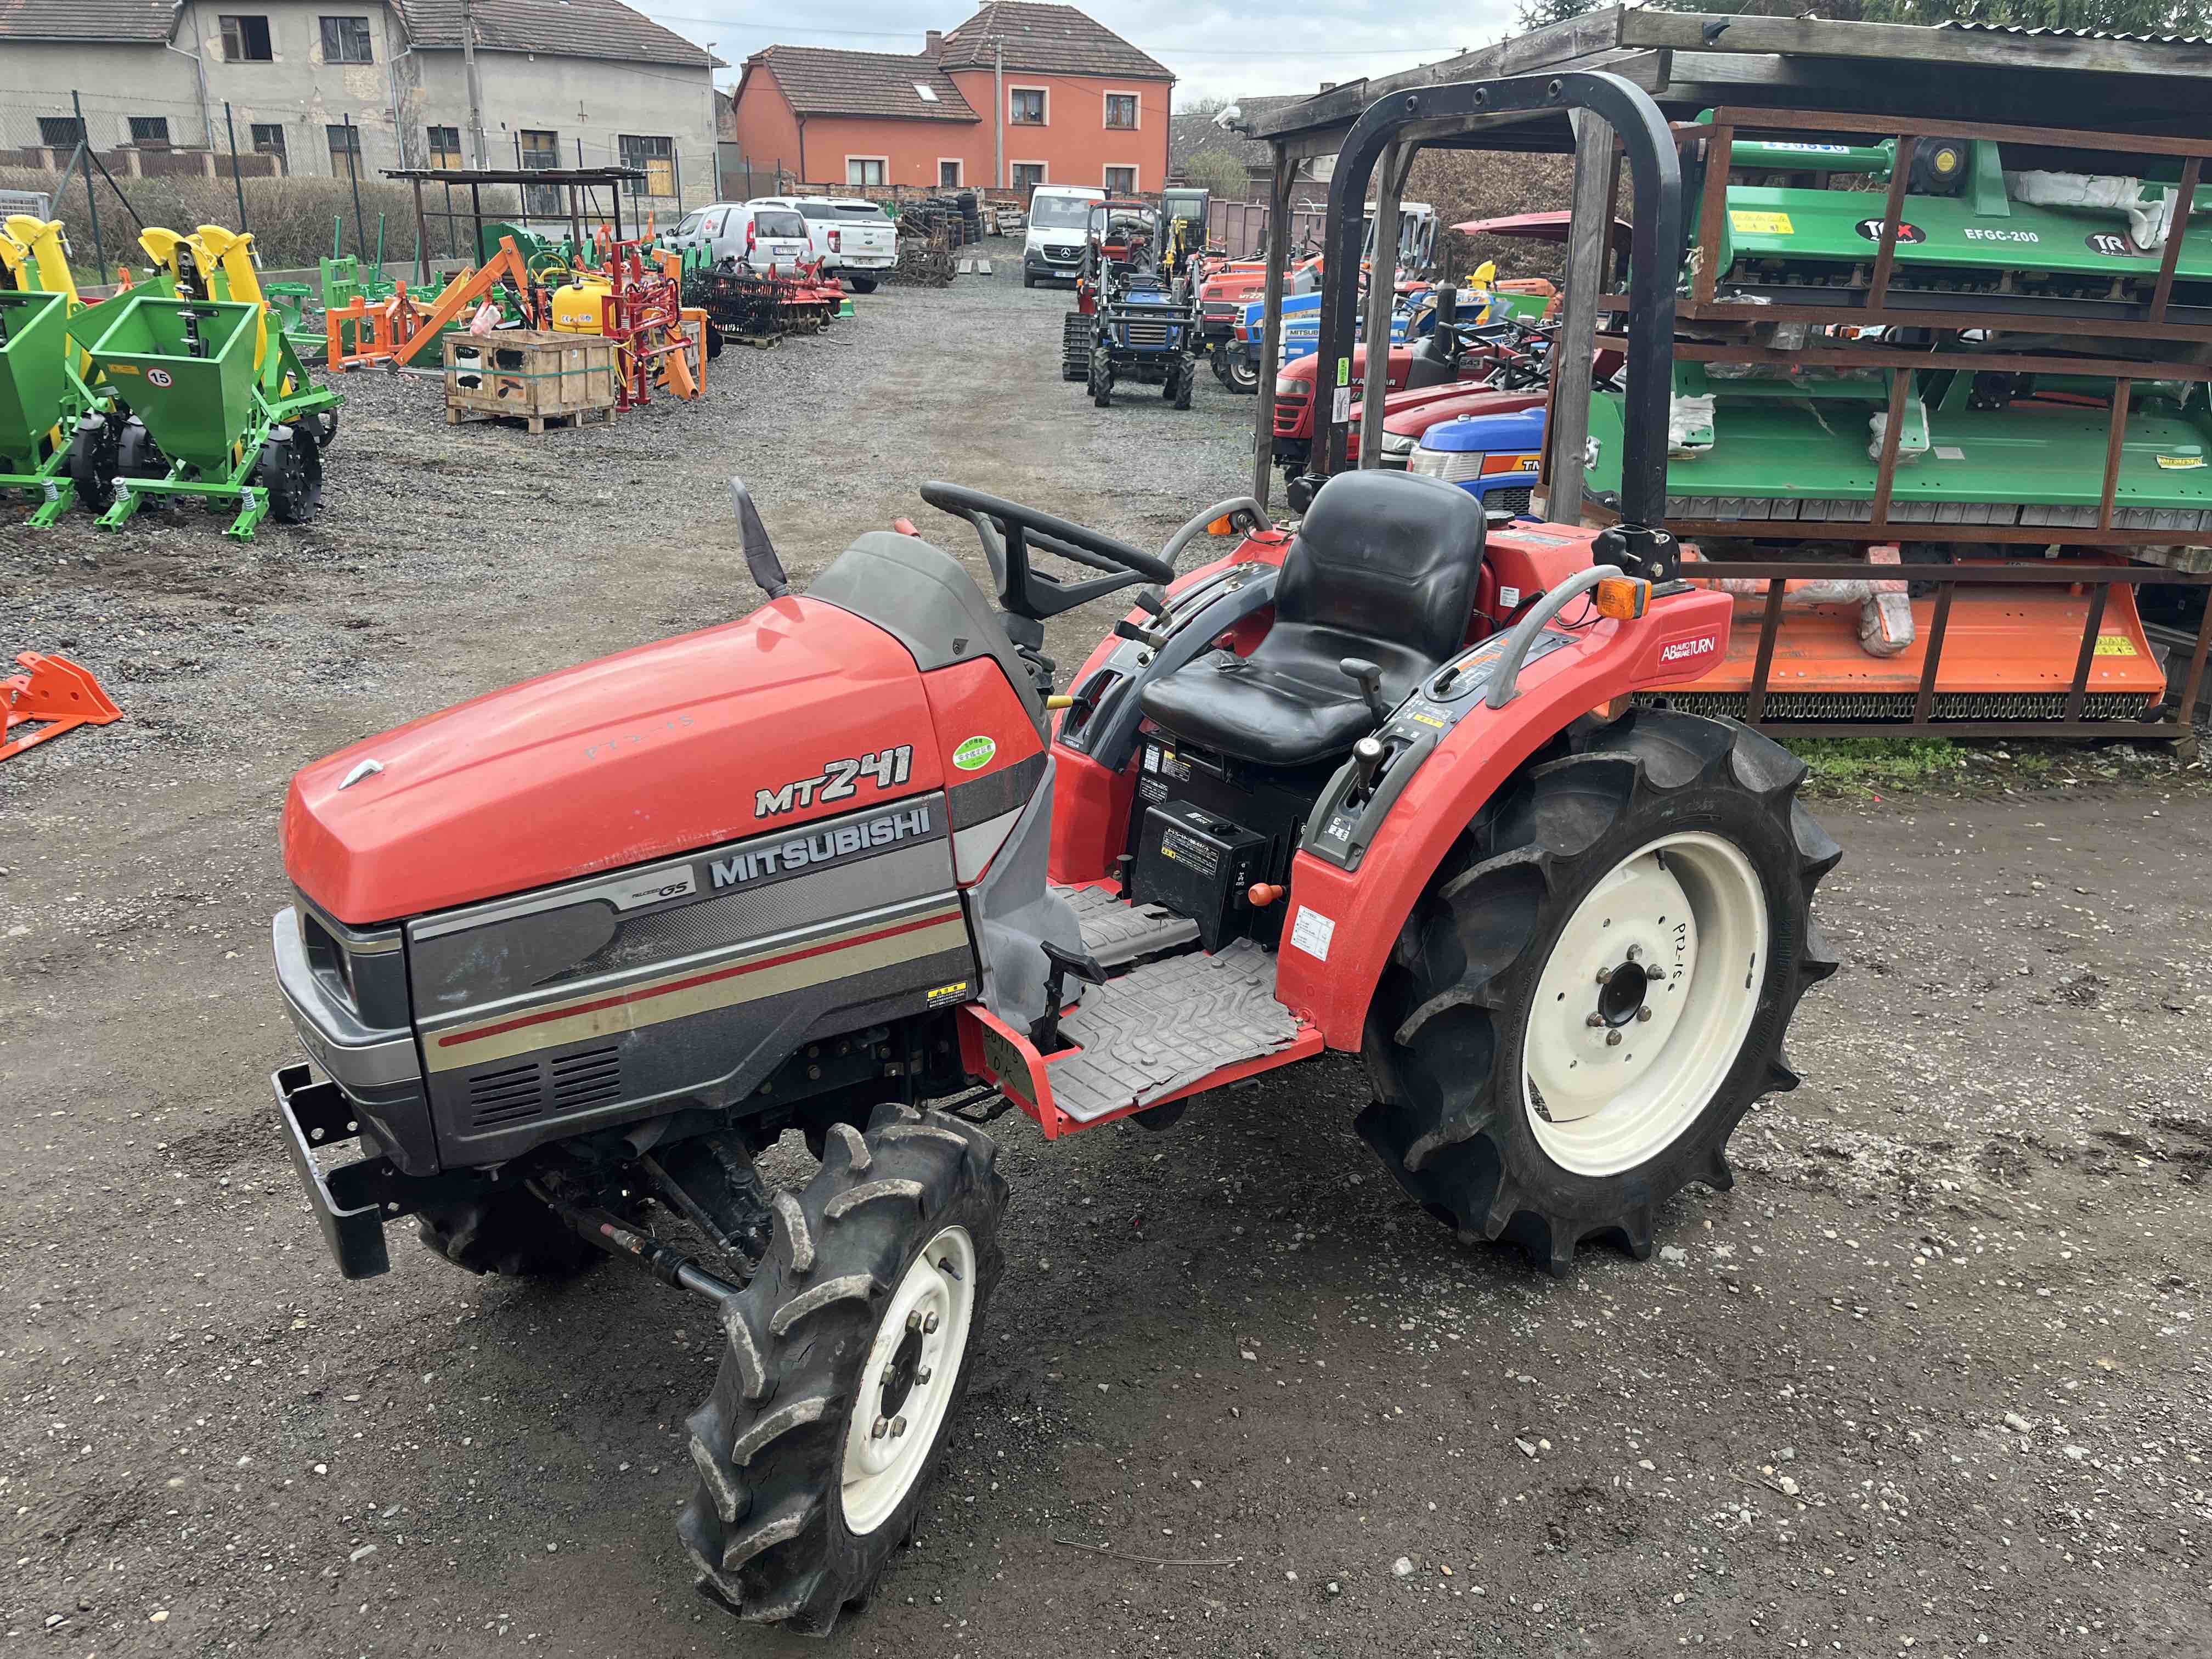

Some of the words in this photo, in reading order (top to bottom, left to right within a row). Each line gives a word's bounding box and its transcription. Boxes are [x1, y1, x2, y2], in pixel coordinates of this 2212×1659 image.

[1964, 228, 2039, 242] EFGC-200
[150, 373, 169, 383] 15
[1661, 646, 1677, 661] AB
[1677, 642, 1690, 651] AUTO
[1690, 636, 1715, 655] TURN
[1676, 649, 1690, 658] BRAKE
[754, 744, 913, 819] MT241
[709, 807, 931, 888] MITSUBISHI
[659, 881, 689, 896] GS
